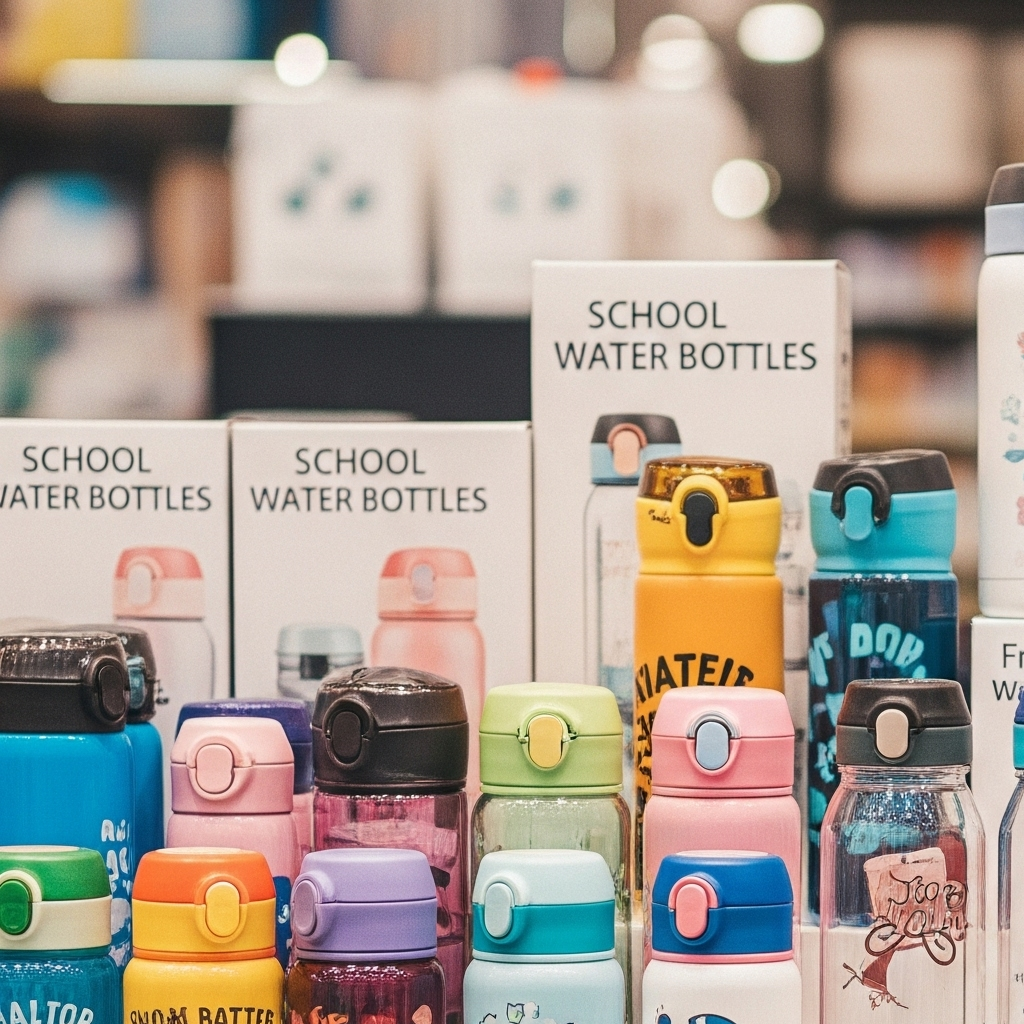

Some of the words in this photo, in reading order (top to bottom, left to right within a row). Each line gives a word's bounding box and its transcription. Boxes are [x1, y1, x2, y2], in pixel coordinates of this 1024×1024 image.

[588, 300, 727, 329] SCHOOL
[554, 341, 668, 370] WATER
[679, 342, 817, 371] BOTTLES
[22, 445, 151, 473] SCHOOL
[295, 447, 426, 475] SCHOOL
[89, 484, 212, 512] BOTTLES
[250, 486, 353, 512] WATER
[363, 487, 487, 513] BOTTLES
